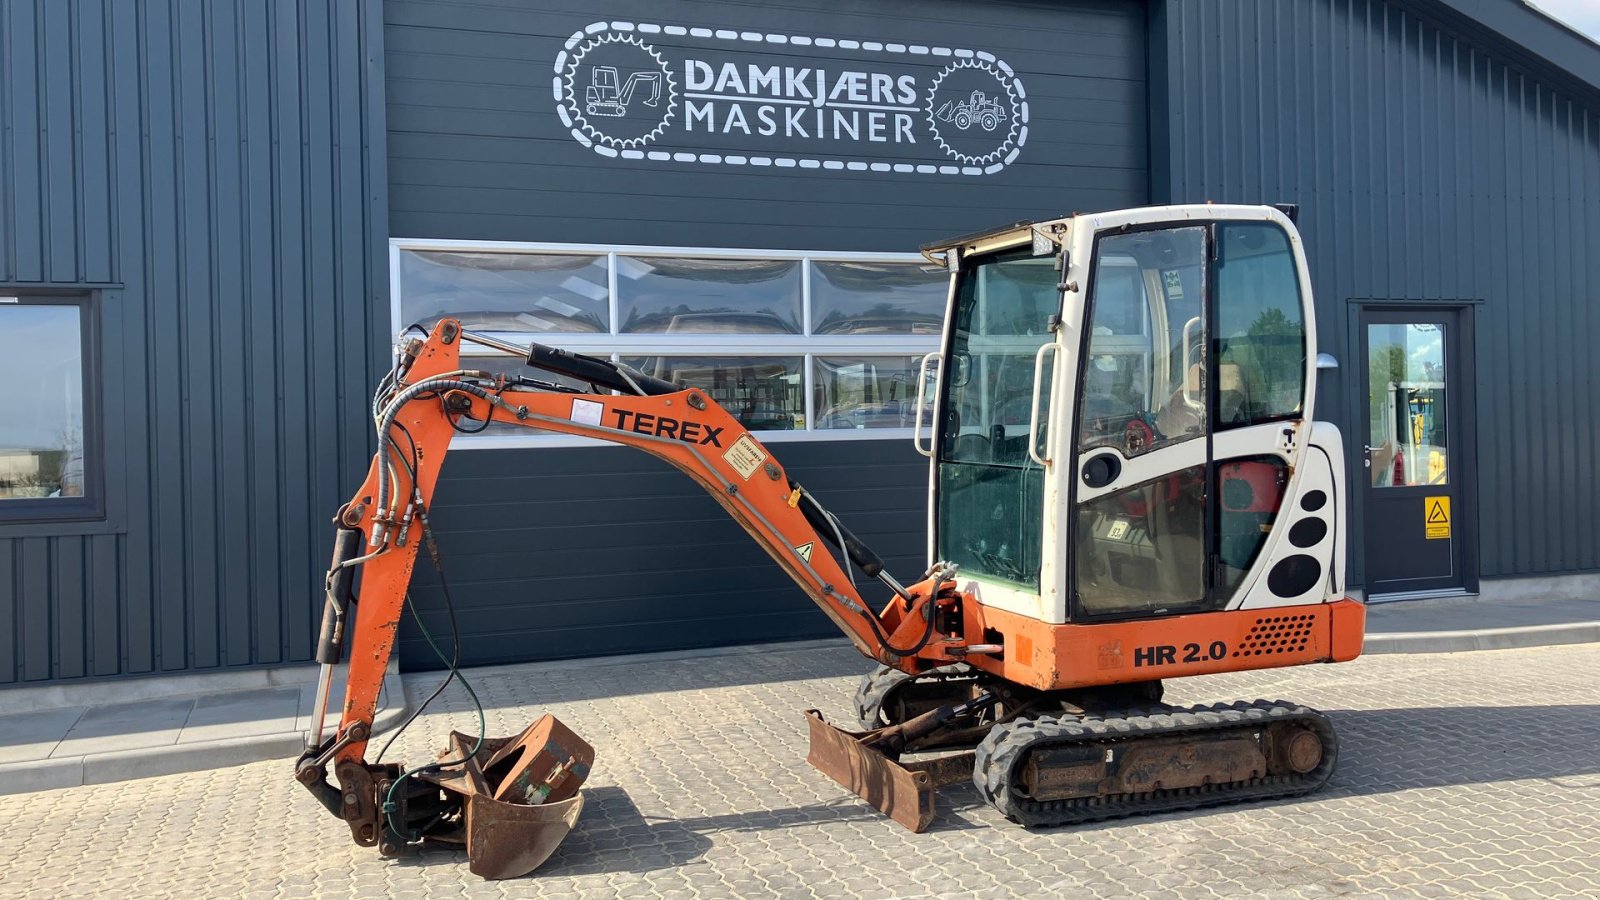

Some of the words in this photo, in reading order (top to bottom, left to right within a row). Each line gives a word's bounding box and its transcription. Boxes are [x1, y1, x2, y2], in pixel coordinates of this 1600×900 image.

[685, 59, 917, 108] DAMKJÆRS
[685, 100, 917, 144] MASKINER
[612, 408, 724, 448] TEREX
[1134, 646, 1176, 667] HR
[1182, 640, 1227, 663] 2.0
